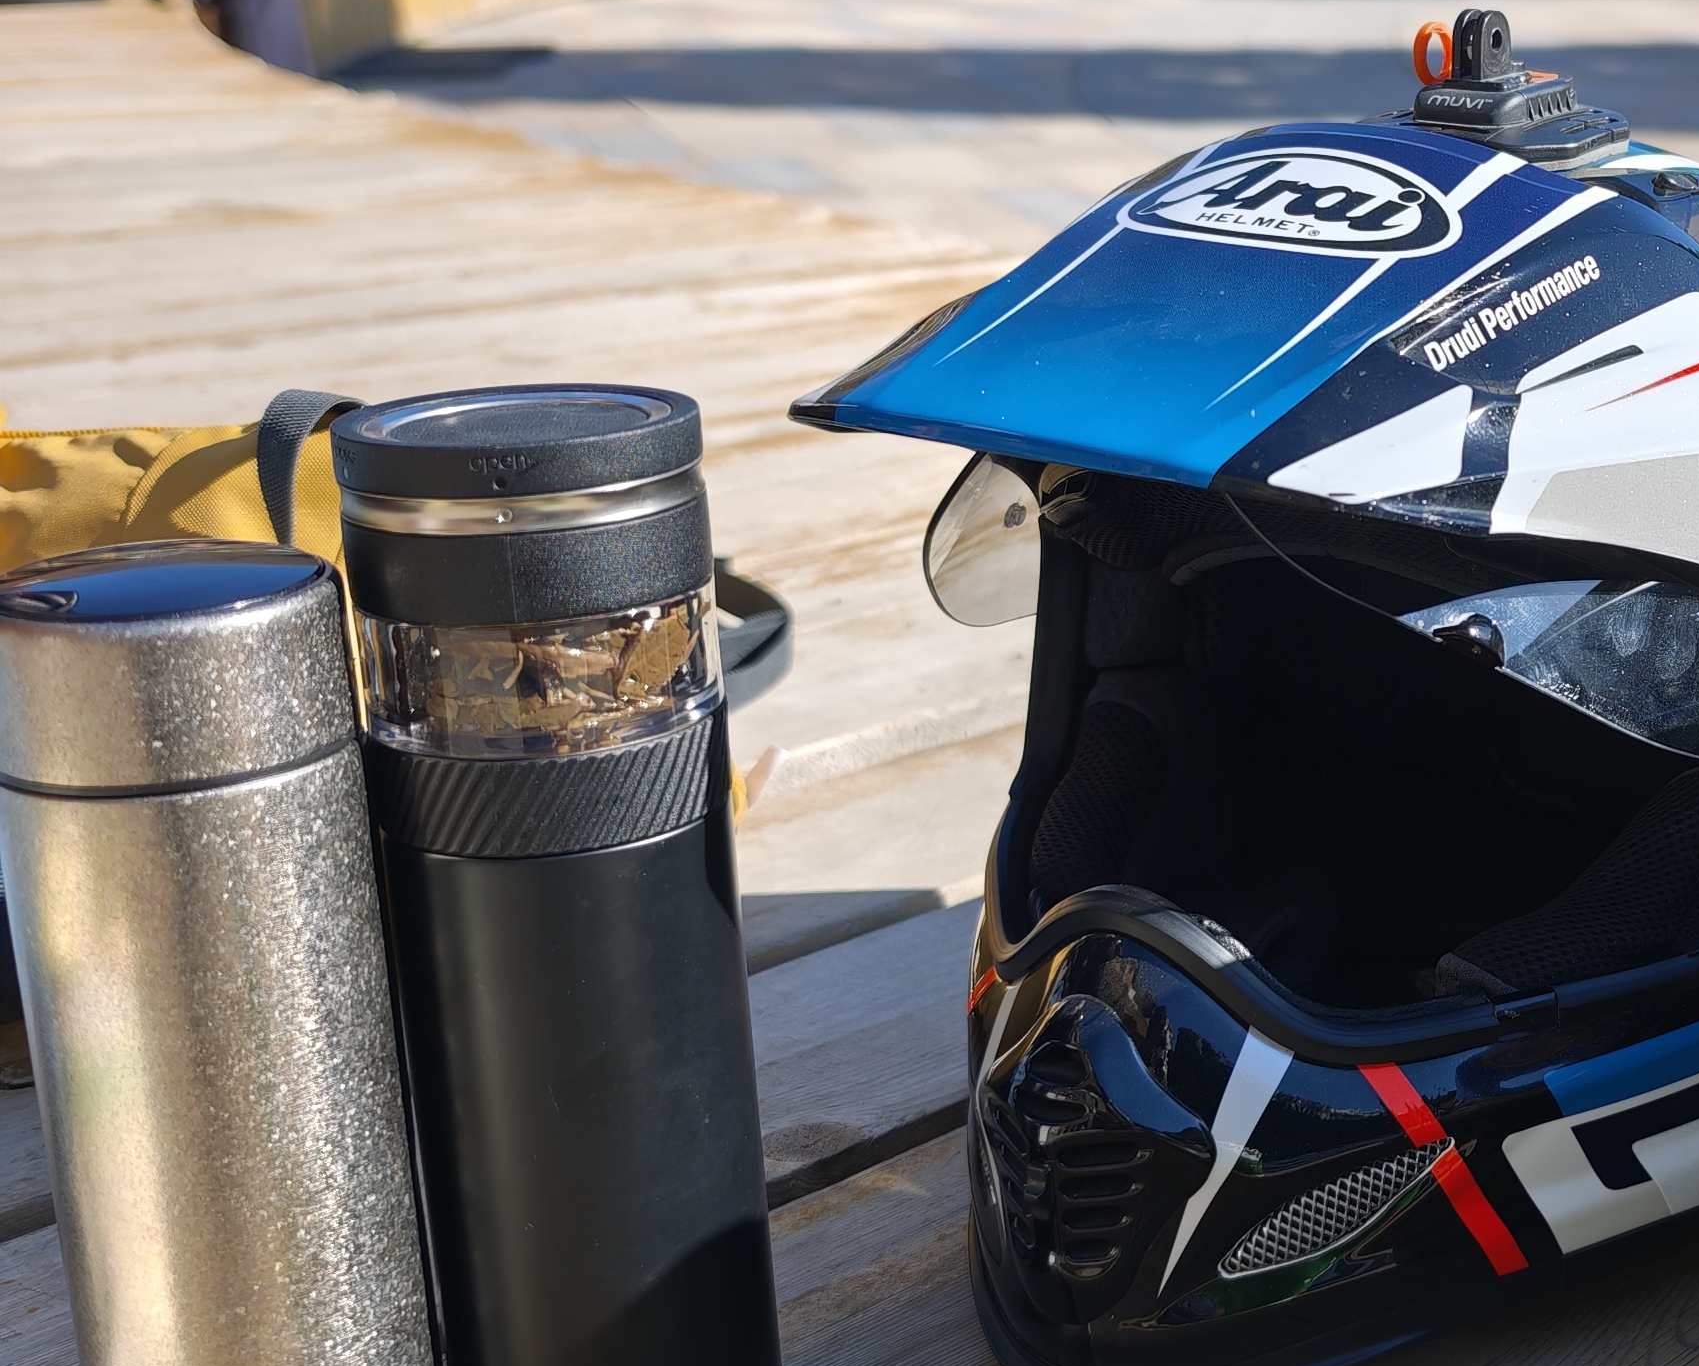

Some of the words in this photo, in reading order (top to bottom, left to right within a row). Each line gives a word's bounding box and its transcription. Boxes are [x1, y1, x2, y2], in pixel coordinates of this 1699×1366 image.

[1138, 160, 1426, 232] Arai
[1423, 315, 1488, 372] Drudi
[1477, 254, 1601, 339] Performance
[468, 453, 529, 475] open
